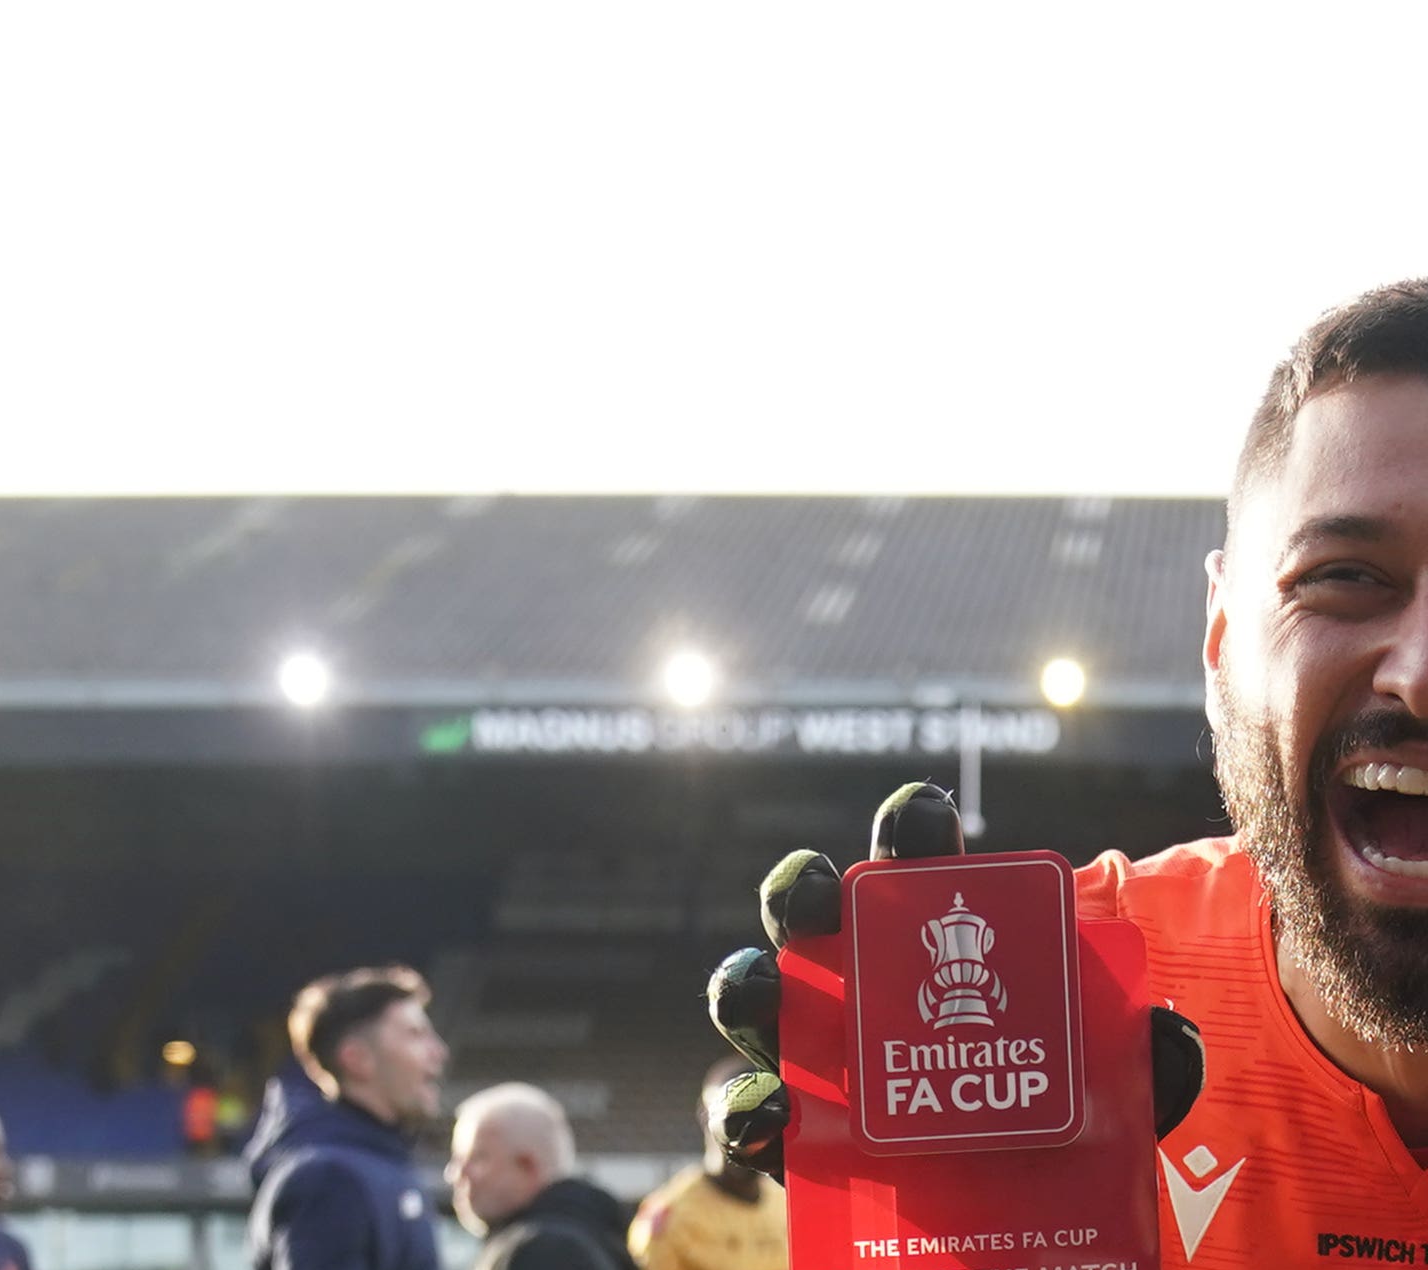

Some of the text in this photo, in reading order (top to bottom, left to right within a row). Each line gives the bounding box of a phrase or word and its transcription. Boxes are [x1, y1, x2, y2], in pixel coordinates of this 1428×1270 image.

[883, 1036, 1046, 1074] Emirates
[886, 1071, 1050, 1116] FA CUP
[853, 1228, 1099, 1259] THE EMIRATES FA CUP
[1317, 1233, 1415, 1265] IPSWICH
